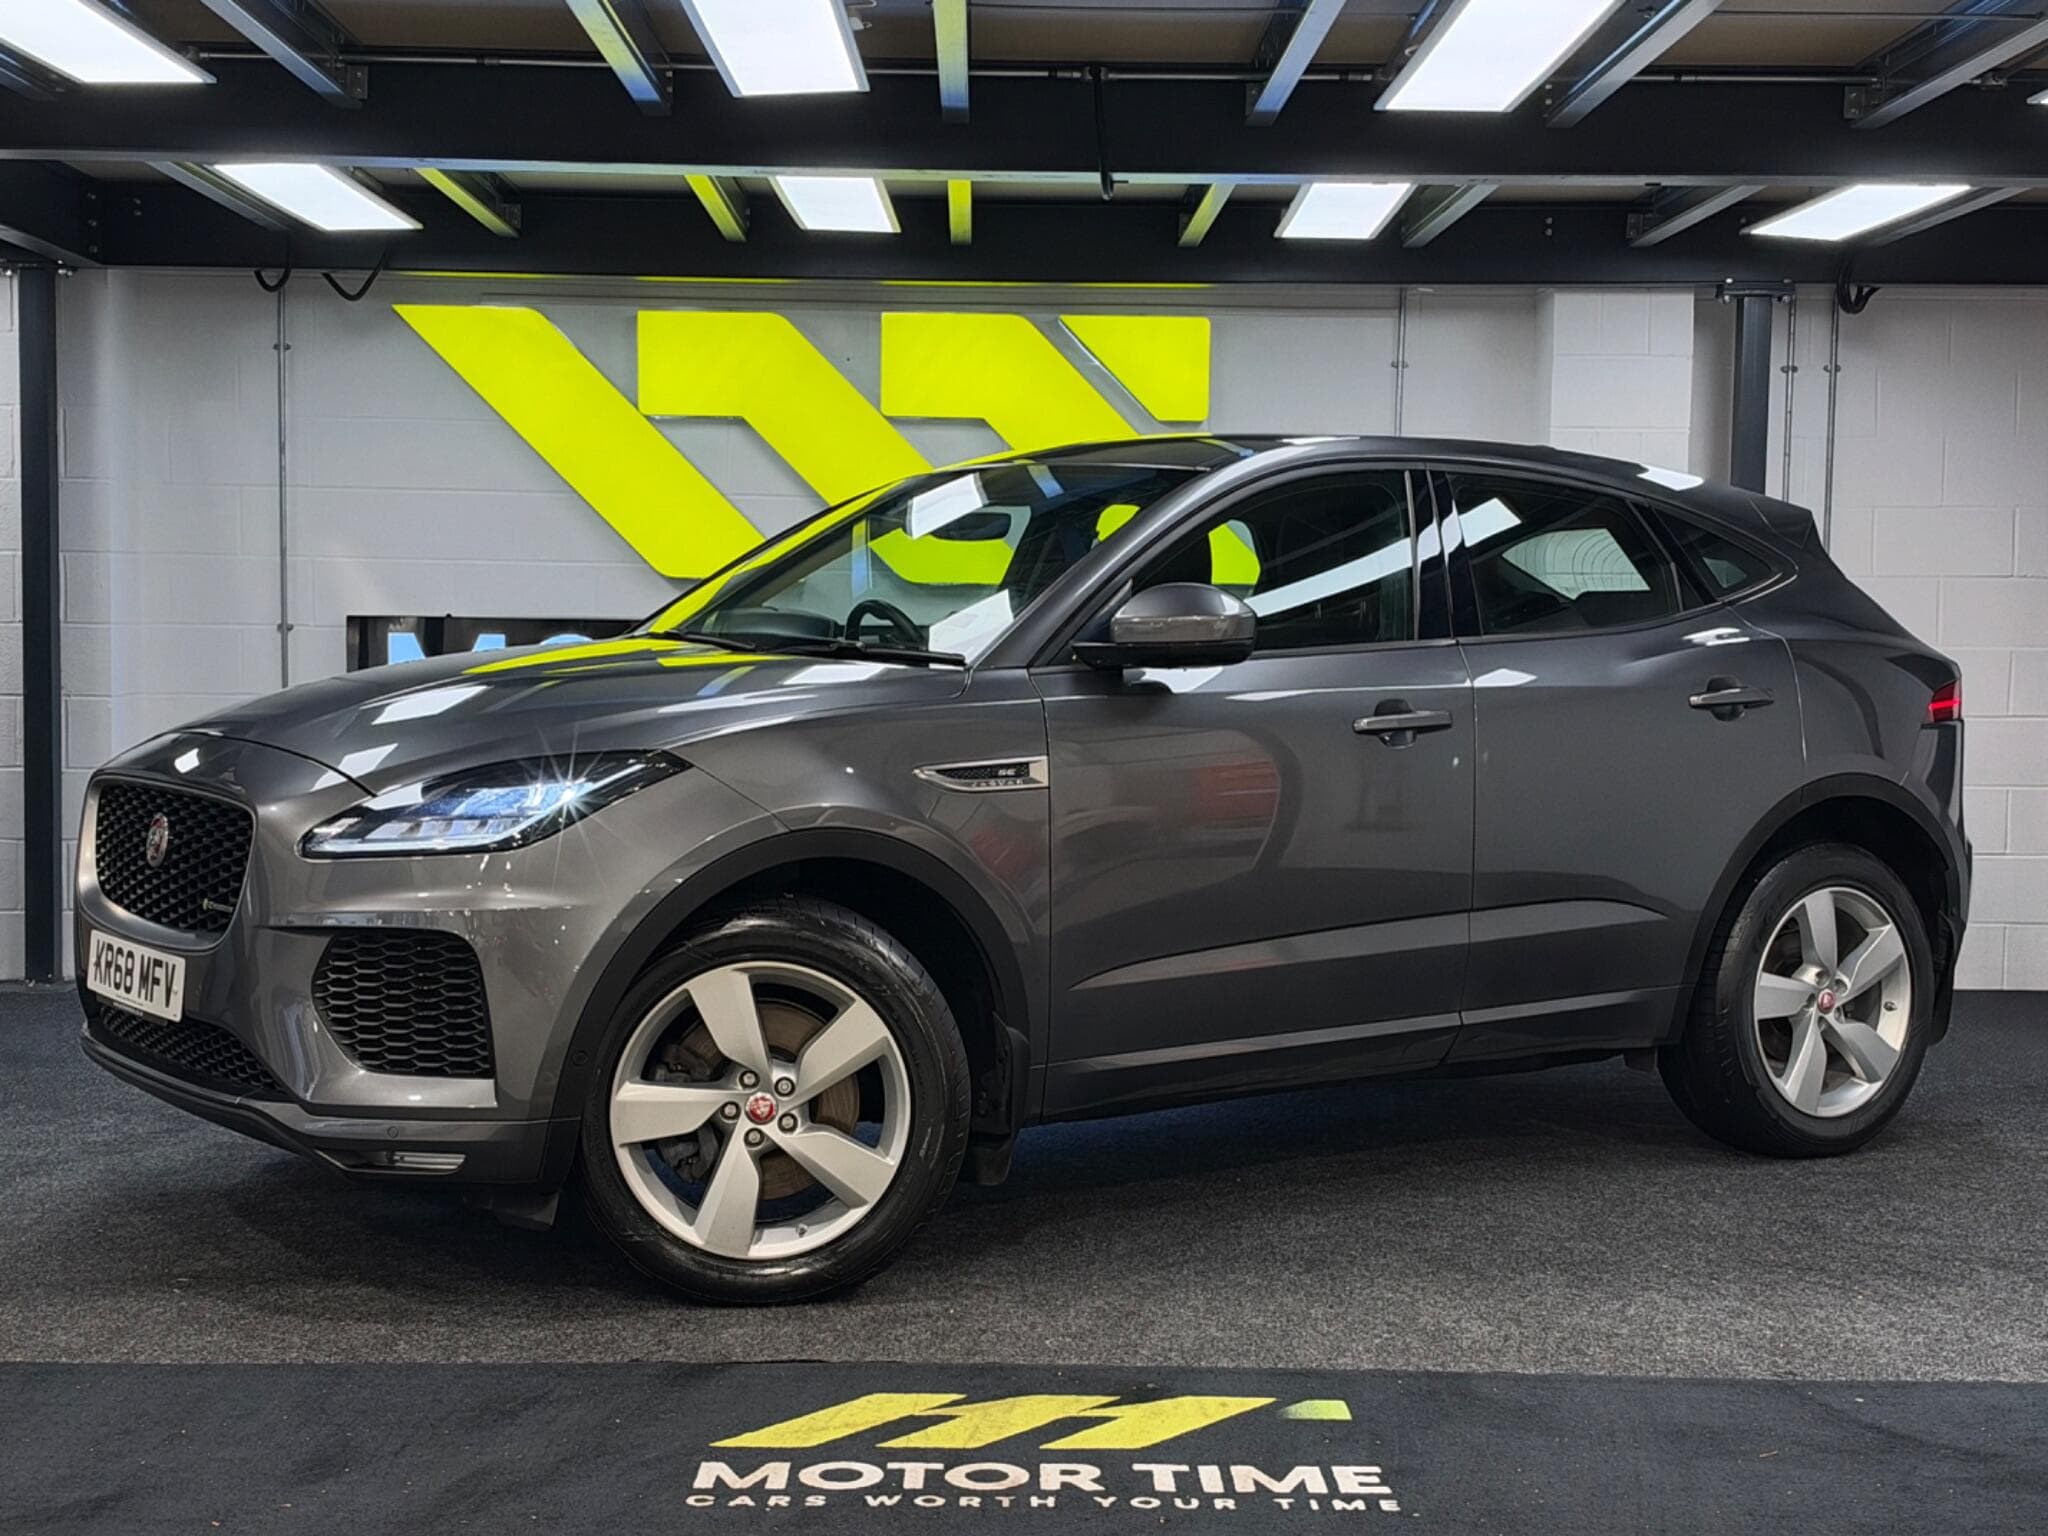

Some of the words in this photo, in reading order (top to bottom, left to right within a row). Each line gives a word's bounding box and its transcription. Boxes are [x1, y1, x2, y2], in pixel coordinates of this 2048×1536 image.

[93, 938, 135, 995] KR68
[137, 953, 176, 1009] MFV
[692, 1460, 1106, 1492] MOTOR
[1131, 1462, 1393, 1494] TIME
[685, 1494, 827, 1507] CARS
[863, 1494, 1057, 1508] WORTH
[1093, 1496, 1237, 1510] YOUR
[1273, 1498, 1402, 1512] TIME
